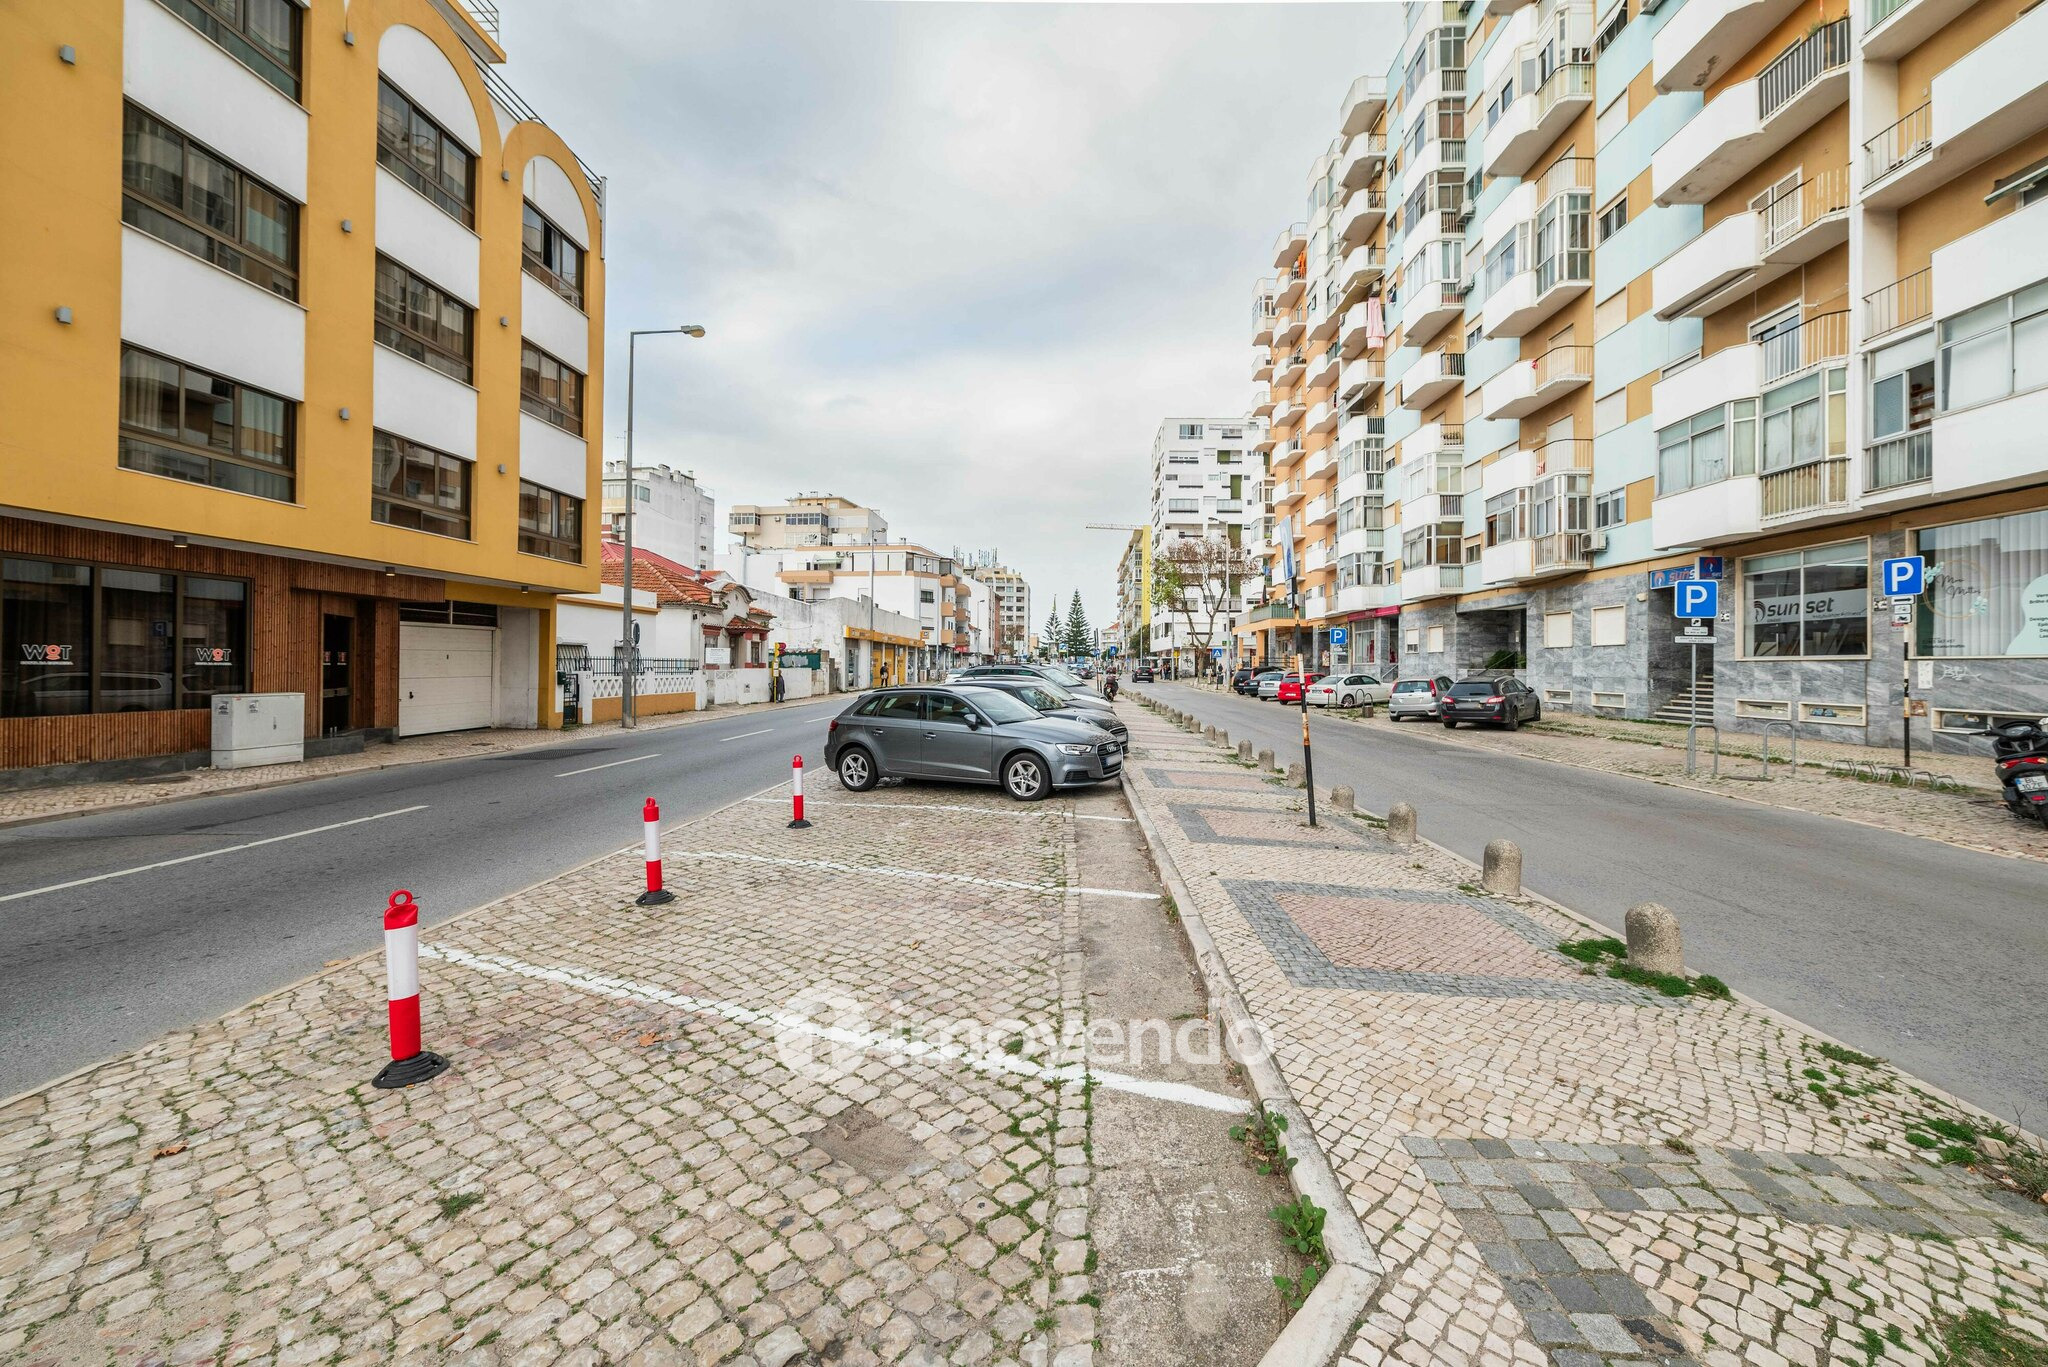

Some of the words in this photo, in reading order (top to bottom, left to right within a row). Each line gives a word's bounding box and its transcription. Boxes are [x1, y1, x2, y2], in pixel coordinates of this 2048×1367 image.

[1891, 562, 1914, 592] P
[1686, 585, 1708, 613] P
[1334, 630, 1342, 642] P
